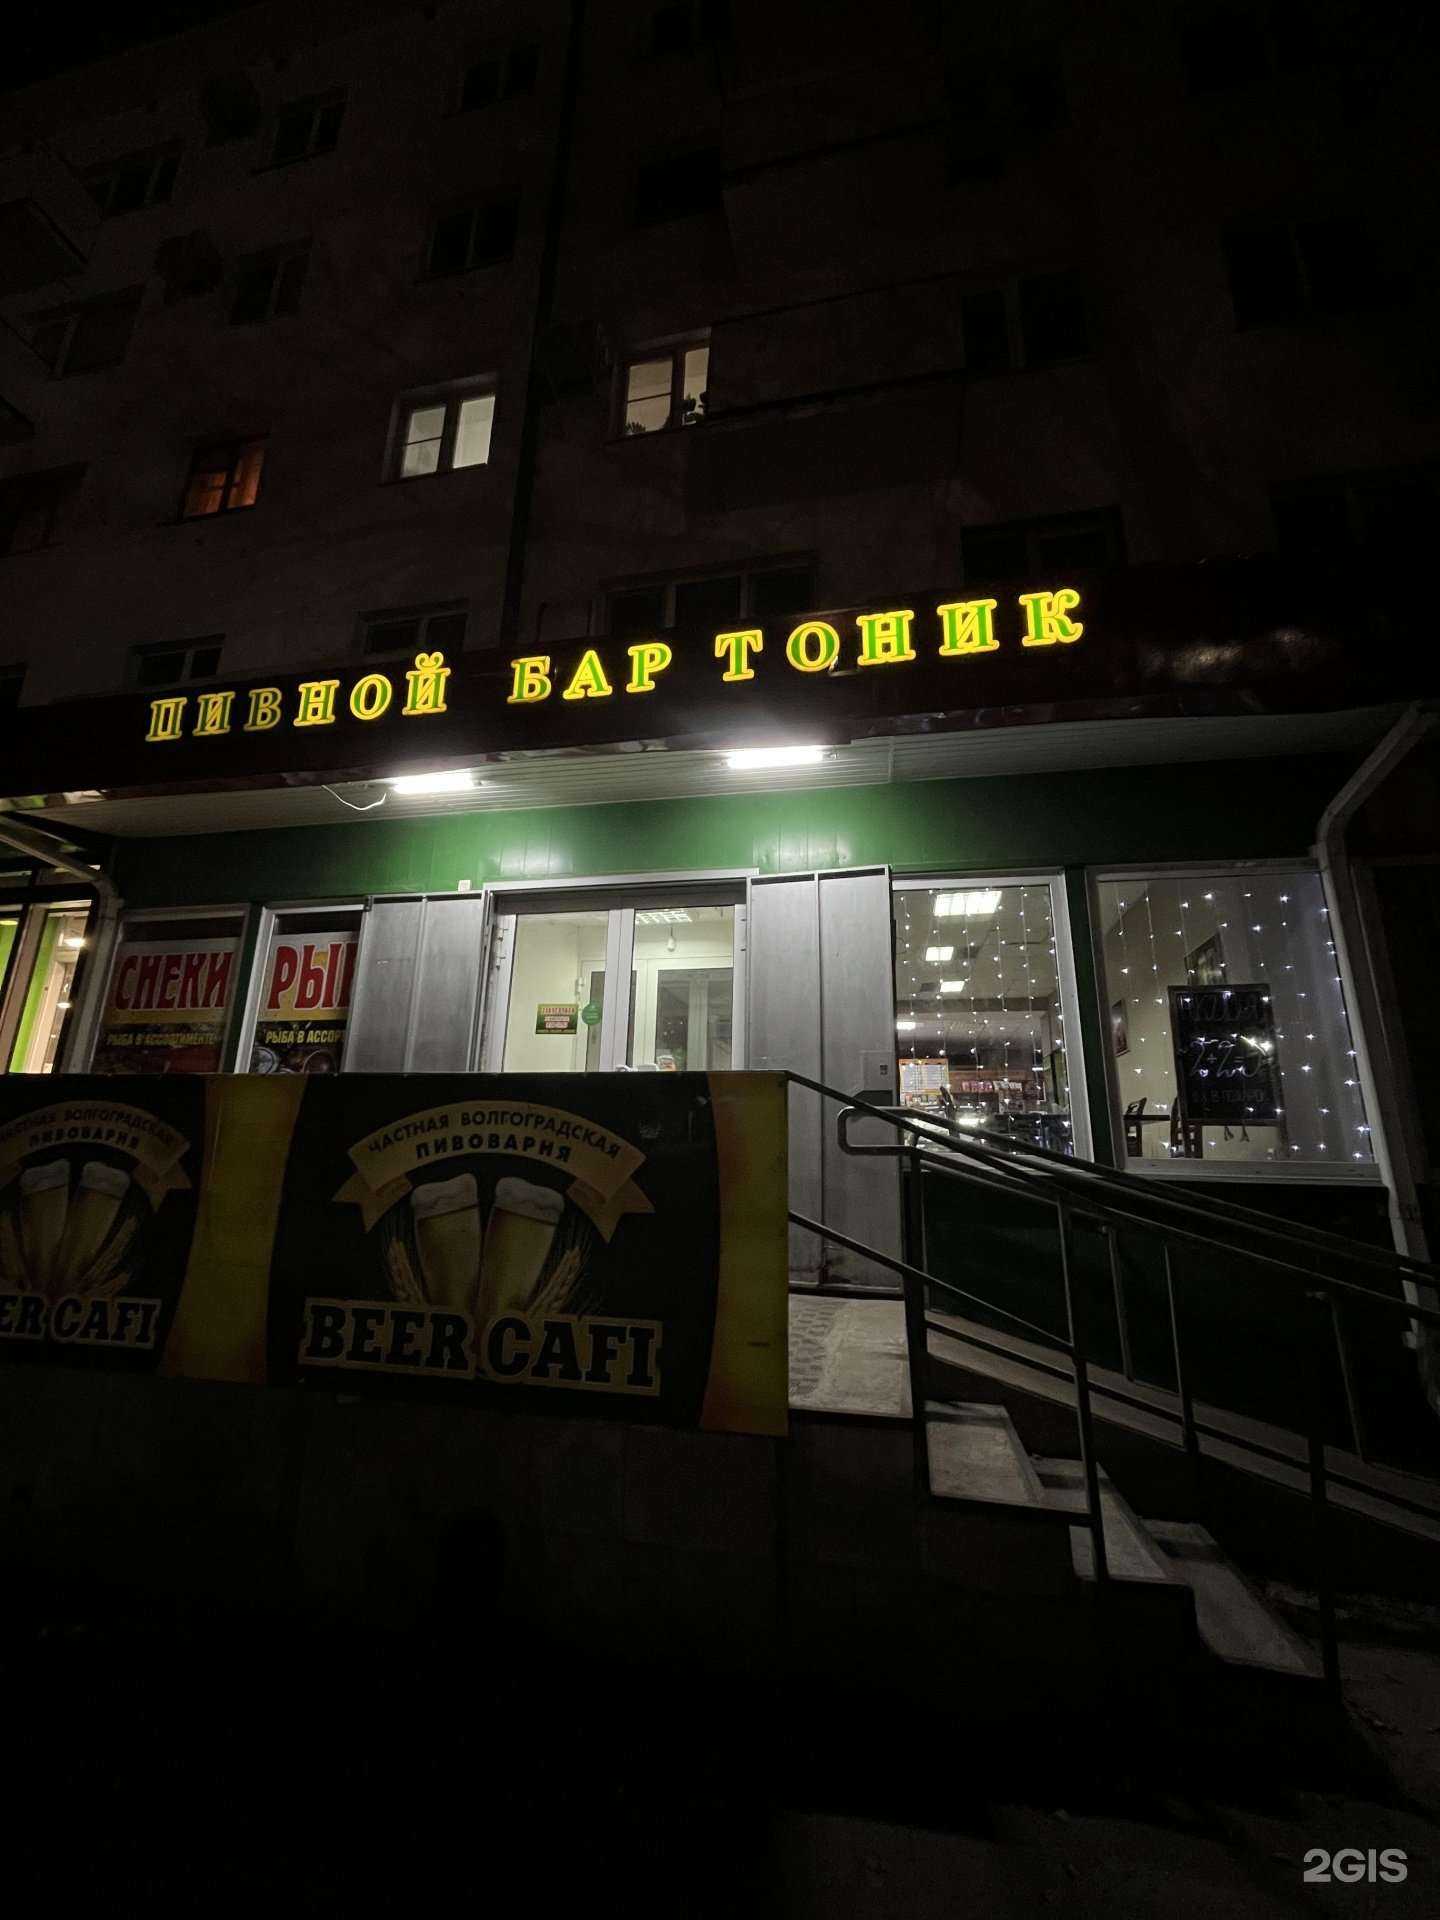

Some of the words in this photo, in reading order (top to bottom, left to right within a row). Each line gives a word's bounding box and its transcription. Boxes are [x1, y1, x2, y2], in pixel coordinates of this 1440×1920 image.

[145, 651, 451, 742] ПИВНОЙ
[507, 642, 673, 704] БАР
[714, 588, 1084, 682] ТОНИК
[115, 952, 234, 1010] СНЕКИ
[265, 1030, 295, 1044] РЫБА
[296, 1030, 305, 1043] В
[368, 1115, 449, 1153] ЧАСТНАЯ
[460, 1109, 621, 1159] ВОЛГОГРАДСКАЯ
[415, 1133, 572, 1162] ПИВОВАРНЯ
[303, 1305, 474, 1372] BEER
[487, 1316, 660, 1383] CAFI
